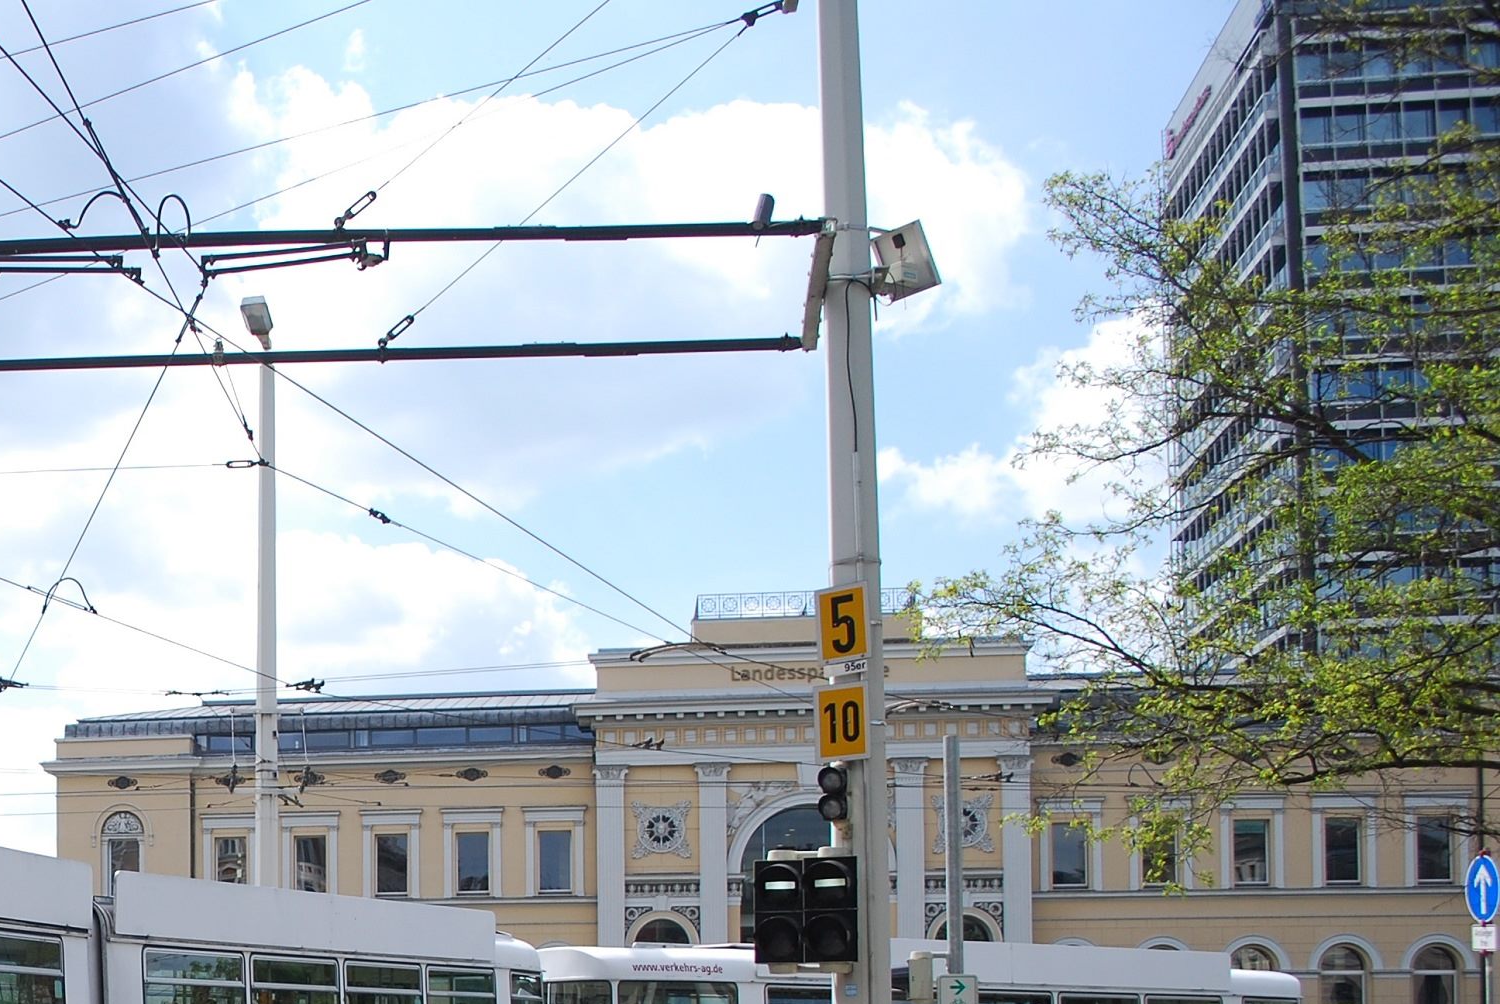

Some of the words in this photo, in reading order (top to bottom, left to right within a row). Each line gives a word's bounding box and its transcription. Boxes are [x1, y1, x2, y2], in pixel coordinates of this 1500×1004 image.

[831, 594, 856, 653] 5
[824, 700, 859, 744] 10
[632, 962, 723, 975] www.verkehrs-ag.de
